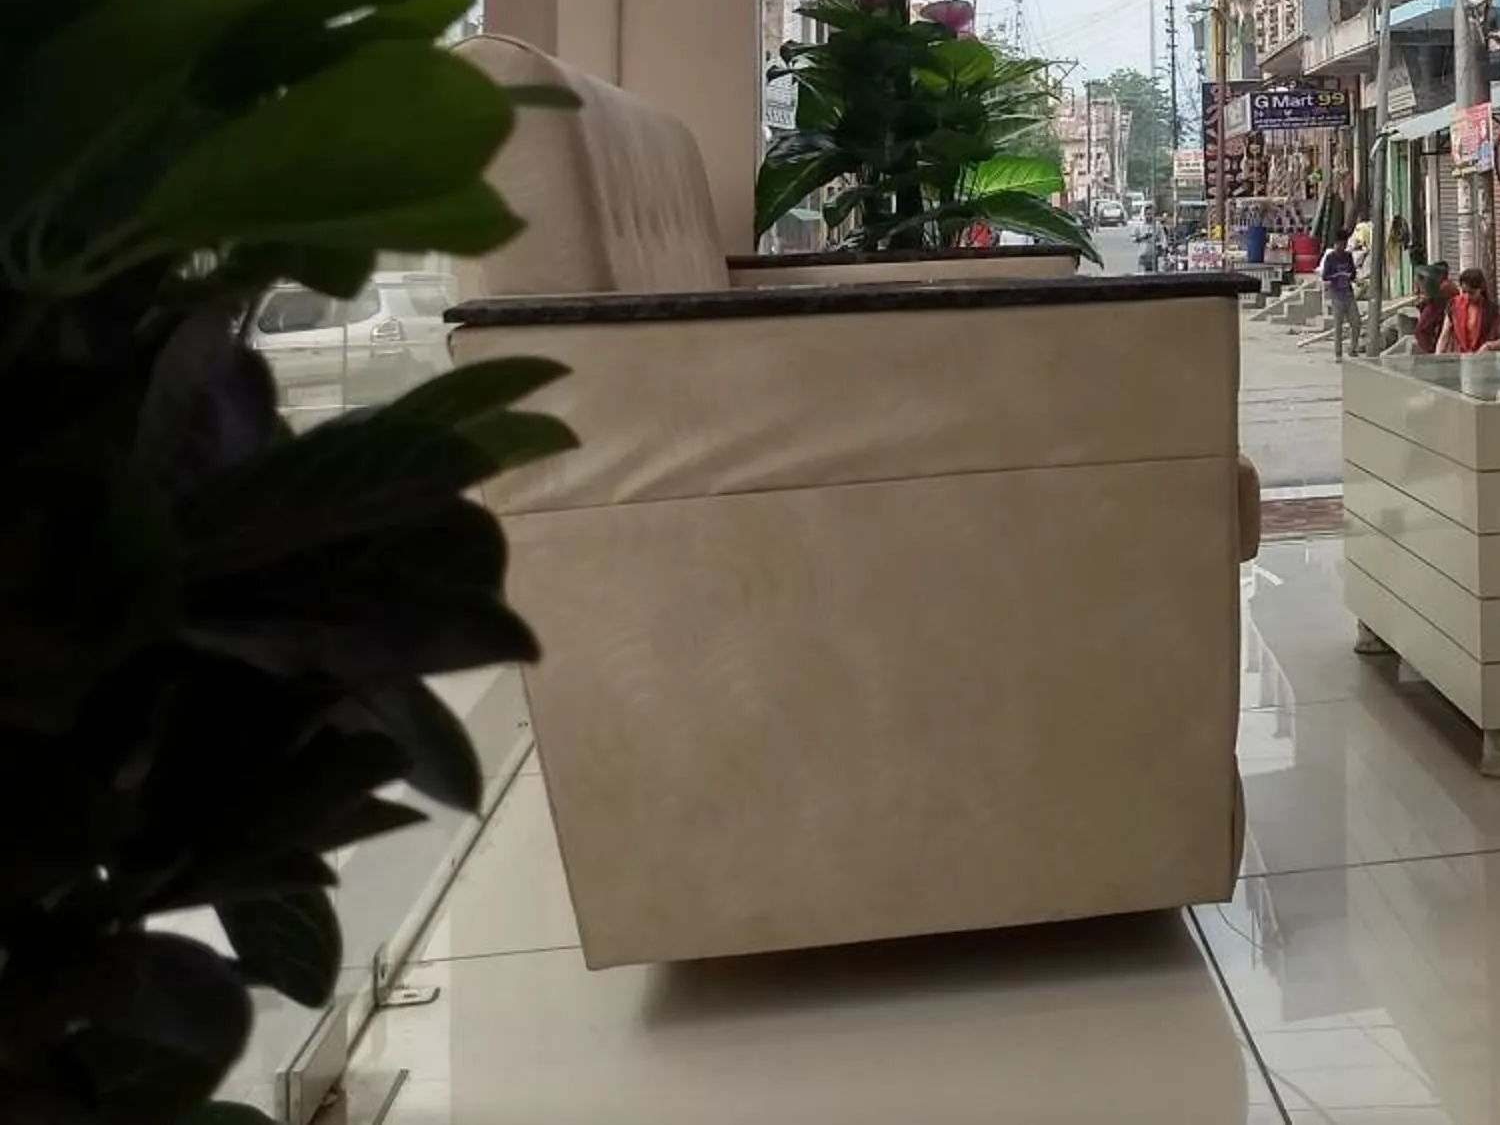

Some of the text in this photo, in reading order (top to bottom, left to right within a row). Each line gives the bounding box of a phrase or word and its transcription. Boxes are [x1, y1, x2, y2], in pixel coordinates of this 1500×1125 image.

[1255, 92, 1345, 108] G Mart 99
